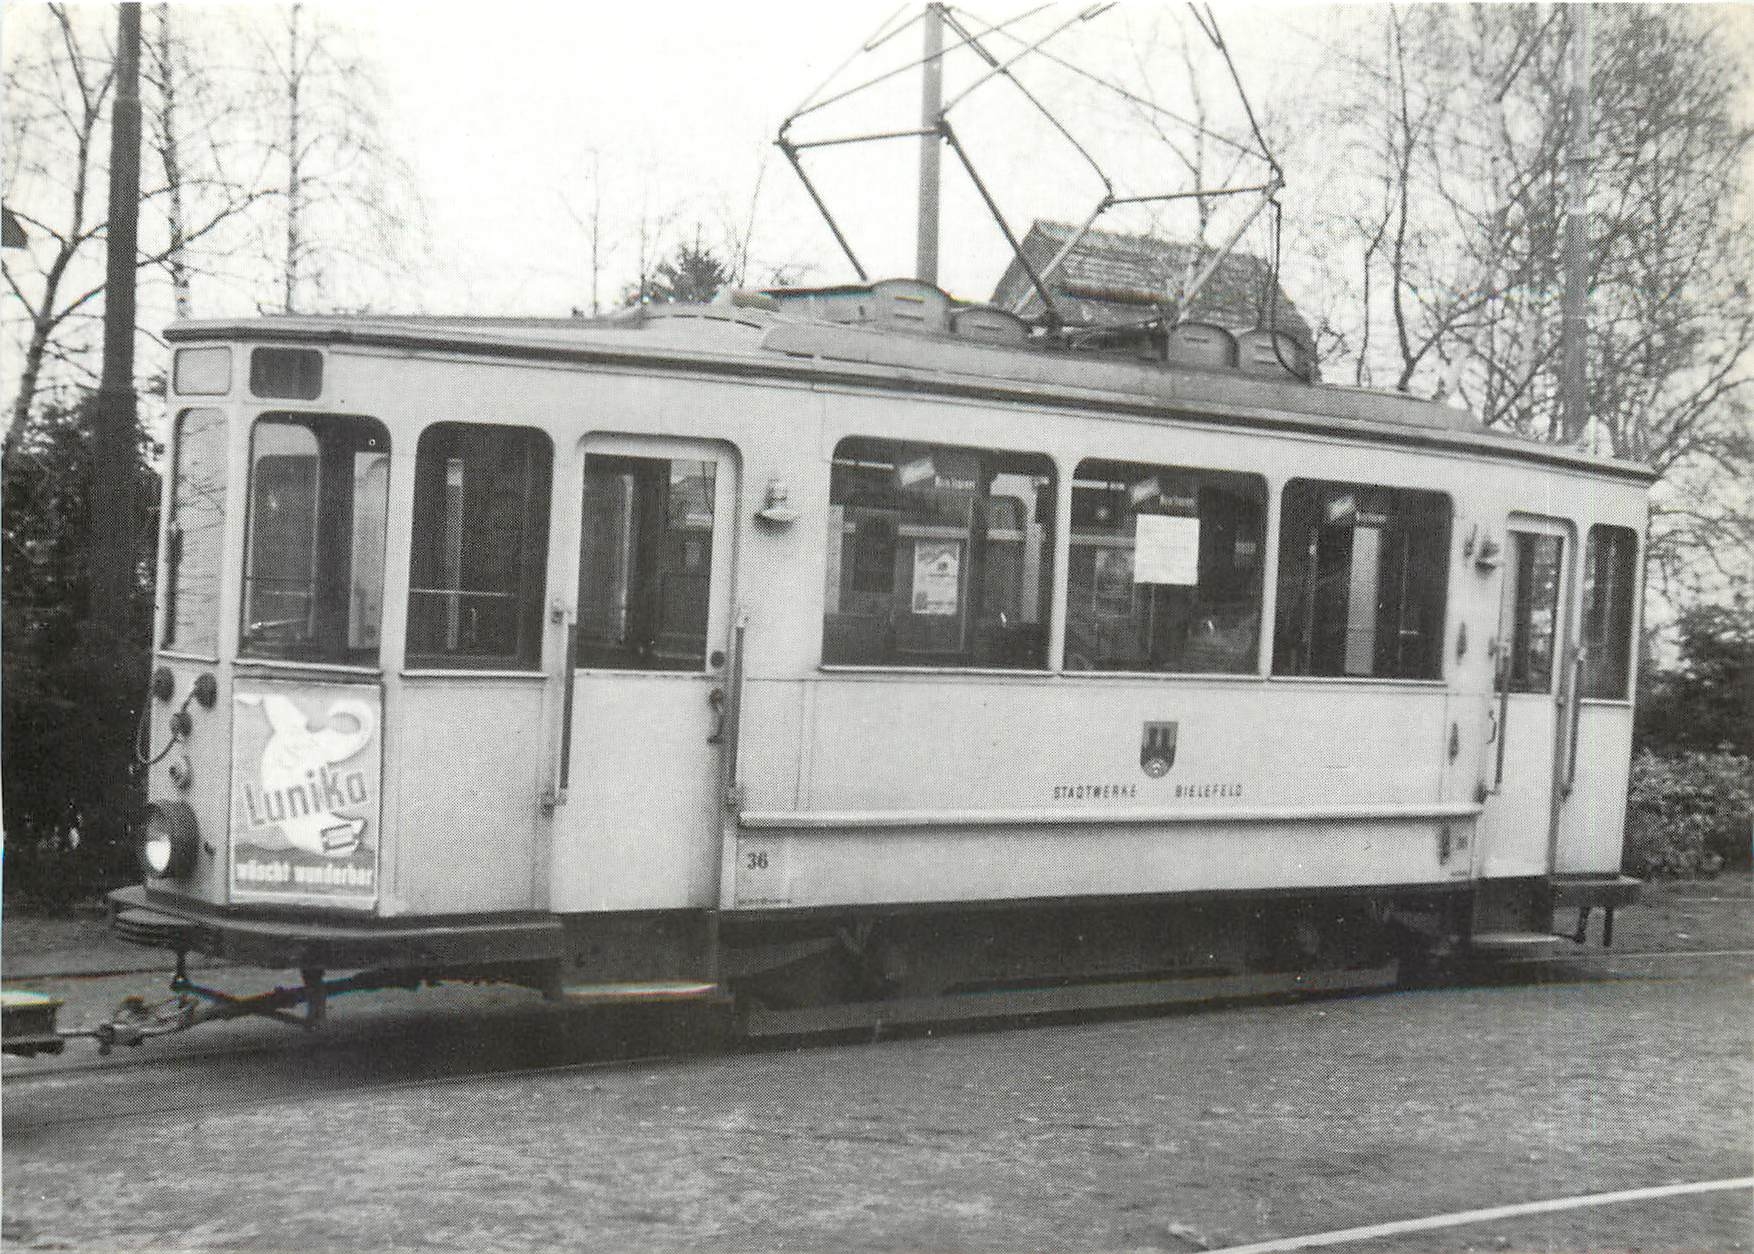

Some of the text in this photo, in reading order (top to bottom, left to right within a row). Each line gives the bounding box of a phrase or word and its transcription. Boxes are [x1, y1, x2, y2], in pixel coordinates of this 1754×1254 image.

[1053, 784, 1243, 800] STADTWERKE BIELEFELD
[747, 851, 769, 870] 36
